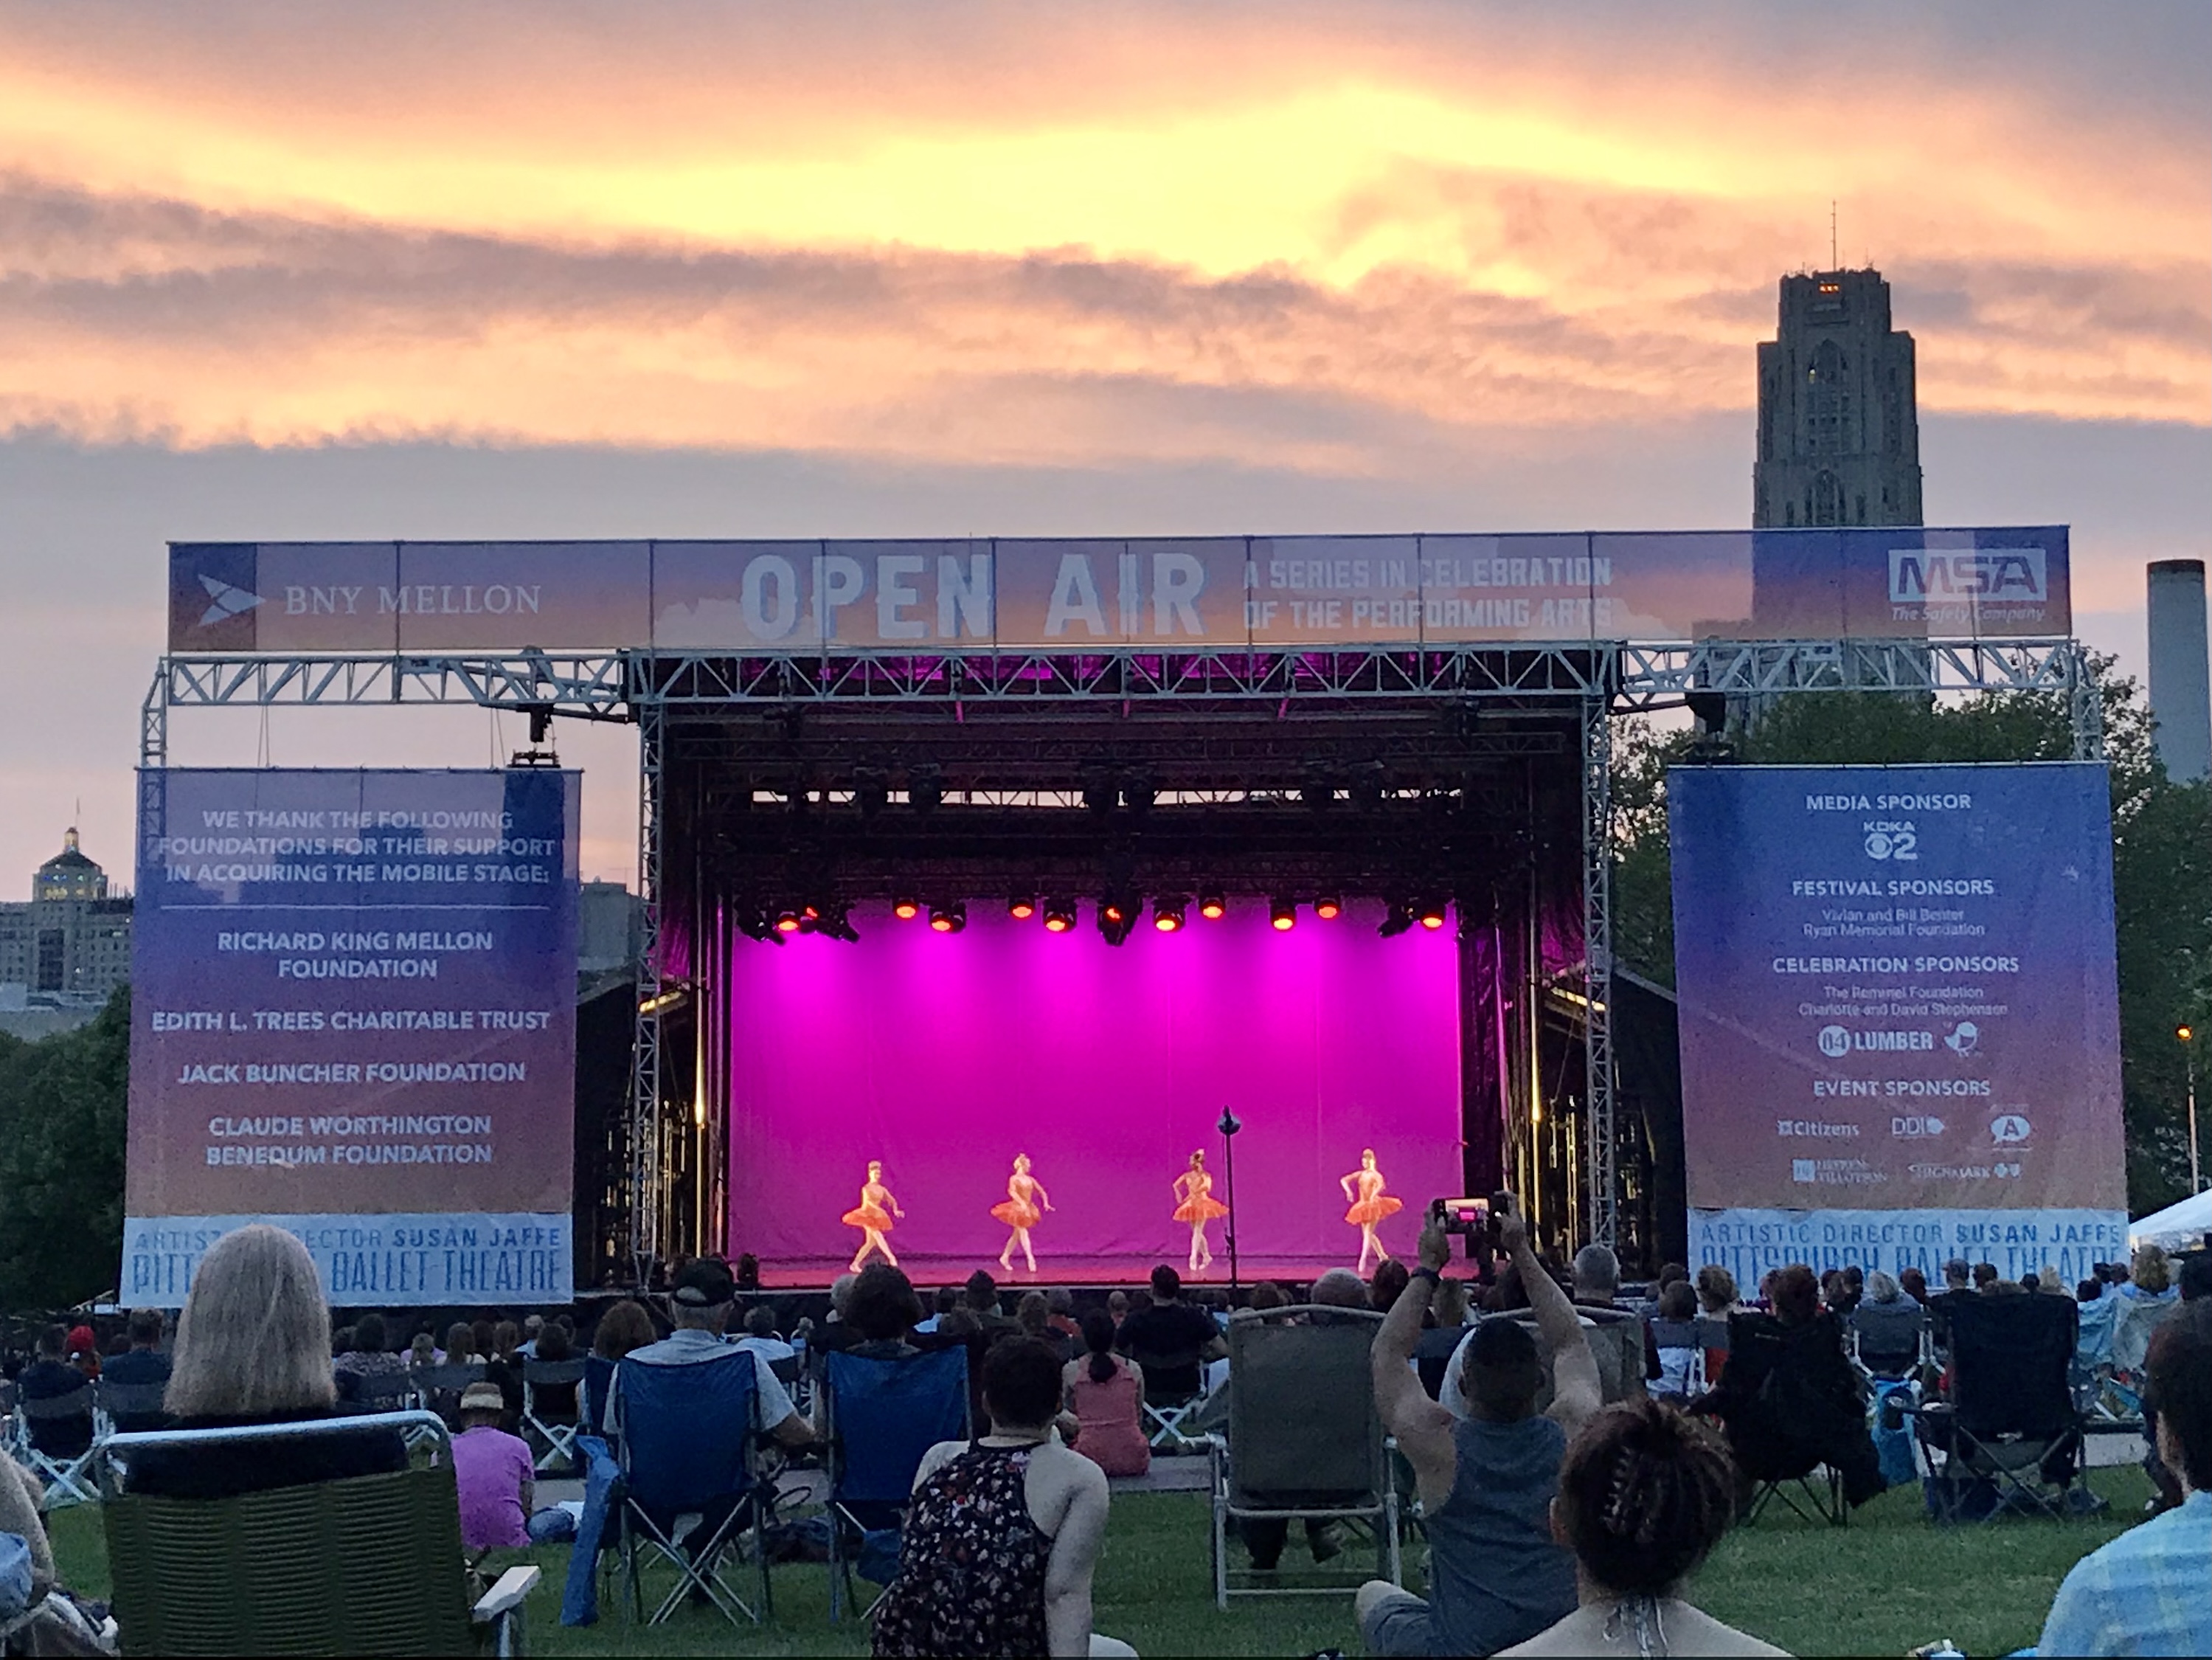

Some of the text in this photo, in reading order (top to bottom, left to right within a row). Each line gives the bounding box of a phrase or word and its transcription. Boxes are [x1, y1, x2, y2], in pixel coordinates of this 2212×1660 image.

[1244, 557, 1612, 589] A SERIES IN CELEBRATION
[1898, 556, 2038, 594] MSA
[285, 584, 542, 615] BNY MELLON
[741, 553, 1207, 640] OPEN AIR
[1244, 598, 1613, 629] OF THE PERFORMING ARTS
[1892, 606, 2045, 623] The Safety Company
[1806, 794, 1972, 811] MEDIA SPONSOR
[203, 810, 513, 829] WE THANK THE FOLLOWING
[1864, 820, 1915, 832] KDKA
[158, 837, 556, 857] FOUNDATIONS FOR THEIR SUPPORT
[1893, 831, 1918, 861] 2
[166, 863, 550, 884] IN ACQUIRING THE MOBILE STAGE:
[1792, 879, 1994, 896] FESTIVAL SPONSORS
[1822, 908, 1863, 922] Vivian
[1867, 908, 1892, 921] and
[1896, 908, 1917, 921] Bill
[218, 931, 493, 950] RICHARD KING MELLON
[1804, 922, 1985, 939] Ryan Memorial Foundation
[279, 958, 438, 978] FOUNDATION
[1772, 955, 2019, 974] CELEBRATION SPONSORS
[1824, 986, 1848, 998] The
[1910, 986, 1984, 998] Foundation
[1799, 1003, 1860, 1016] Charlotte
[1864, 1003, 1888, 1016] and
[1892, 1002, 1929, 1015] David
[152, 1011, 550, 1031] EDITH L. TREES CHARITABLE TRUST
[1854, 1031, 1934, 1051] LUMBER
[178, 1062, 526, 1084] JACK BUNCHER FOUNDATION
[1814, 1079, 1991, 1097] EVENT SPONSORS
[209, 1115, 492, 1136] CLAUDE WORTHINGTON
[1794, 1120, 1860, 1137] Citizens
[1891, 1117, 1927, 1136] DDI
[207, 1144, 493, 1166] BENEDUM FOUNDATION
[135, 1228, 561, 1250] ARTIS ECTOR SUSAN JAFFE
[1702, 1222, 2121, 1244] ARTISTIC DIRECTOR SUSAN JAFFE
[332, 1248, 561, 1292] BALLET THEATRE
[1896, 1245, 1991, 1287] BAL
